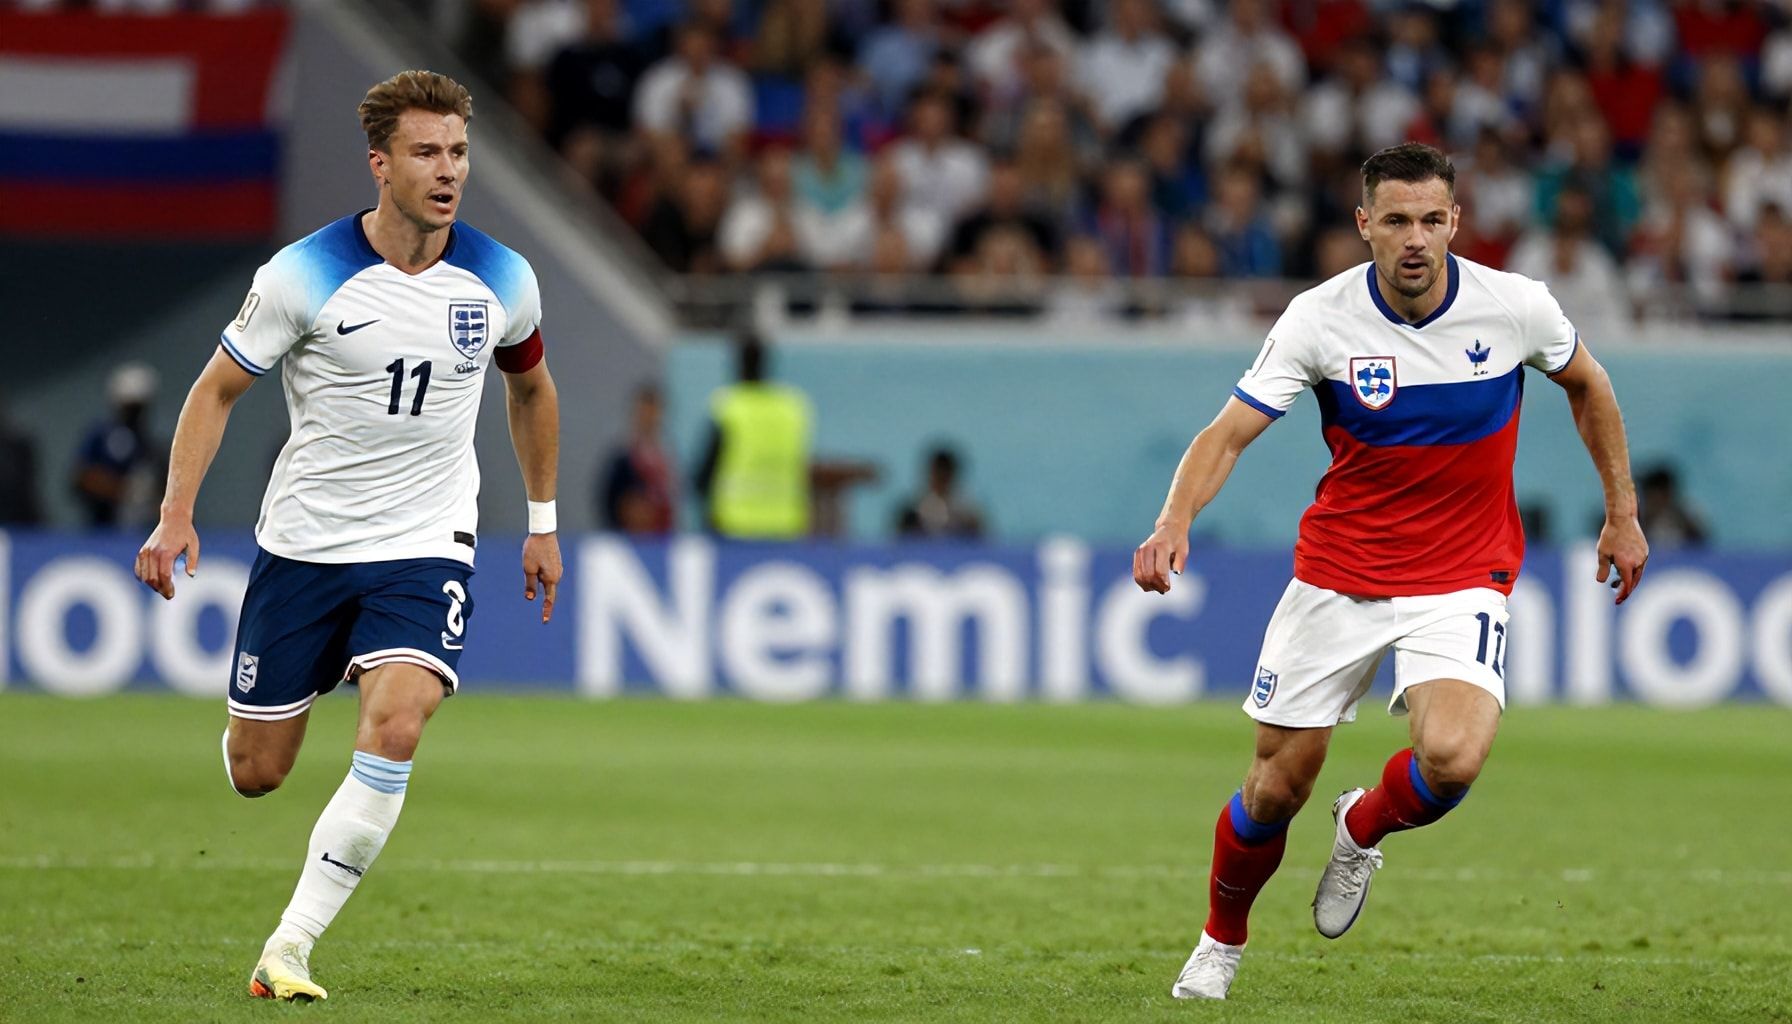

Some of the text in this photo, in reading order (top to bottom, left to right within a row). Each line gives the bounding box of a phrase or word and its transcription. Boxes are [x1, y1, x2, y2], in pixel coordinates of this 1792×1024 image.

[385, 358, 432, 416] 11
[0, 528, 250, 697] oo
[576, 535, 1205, 704] Nemic
